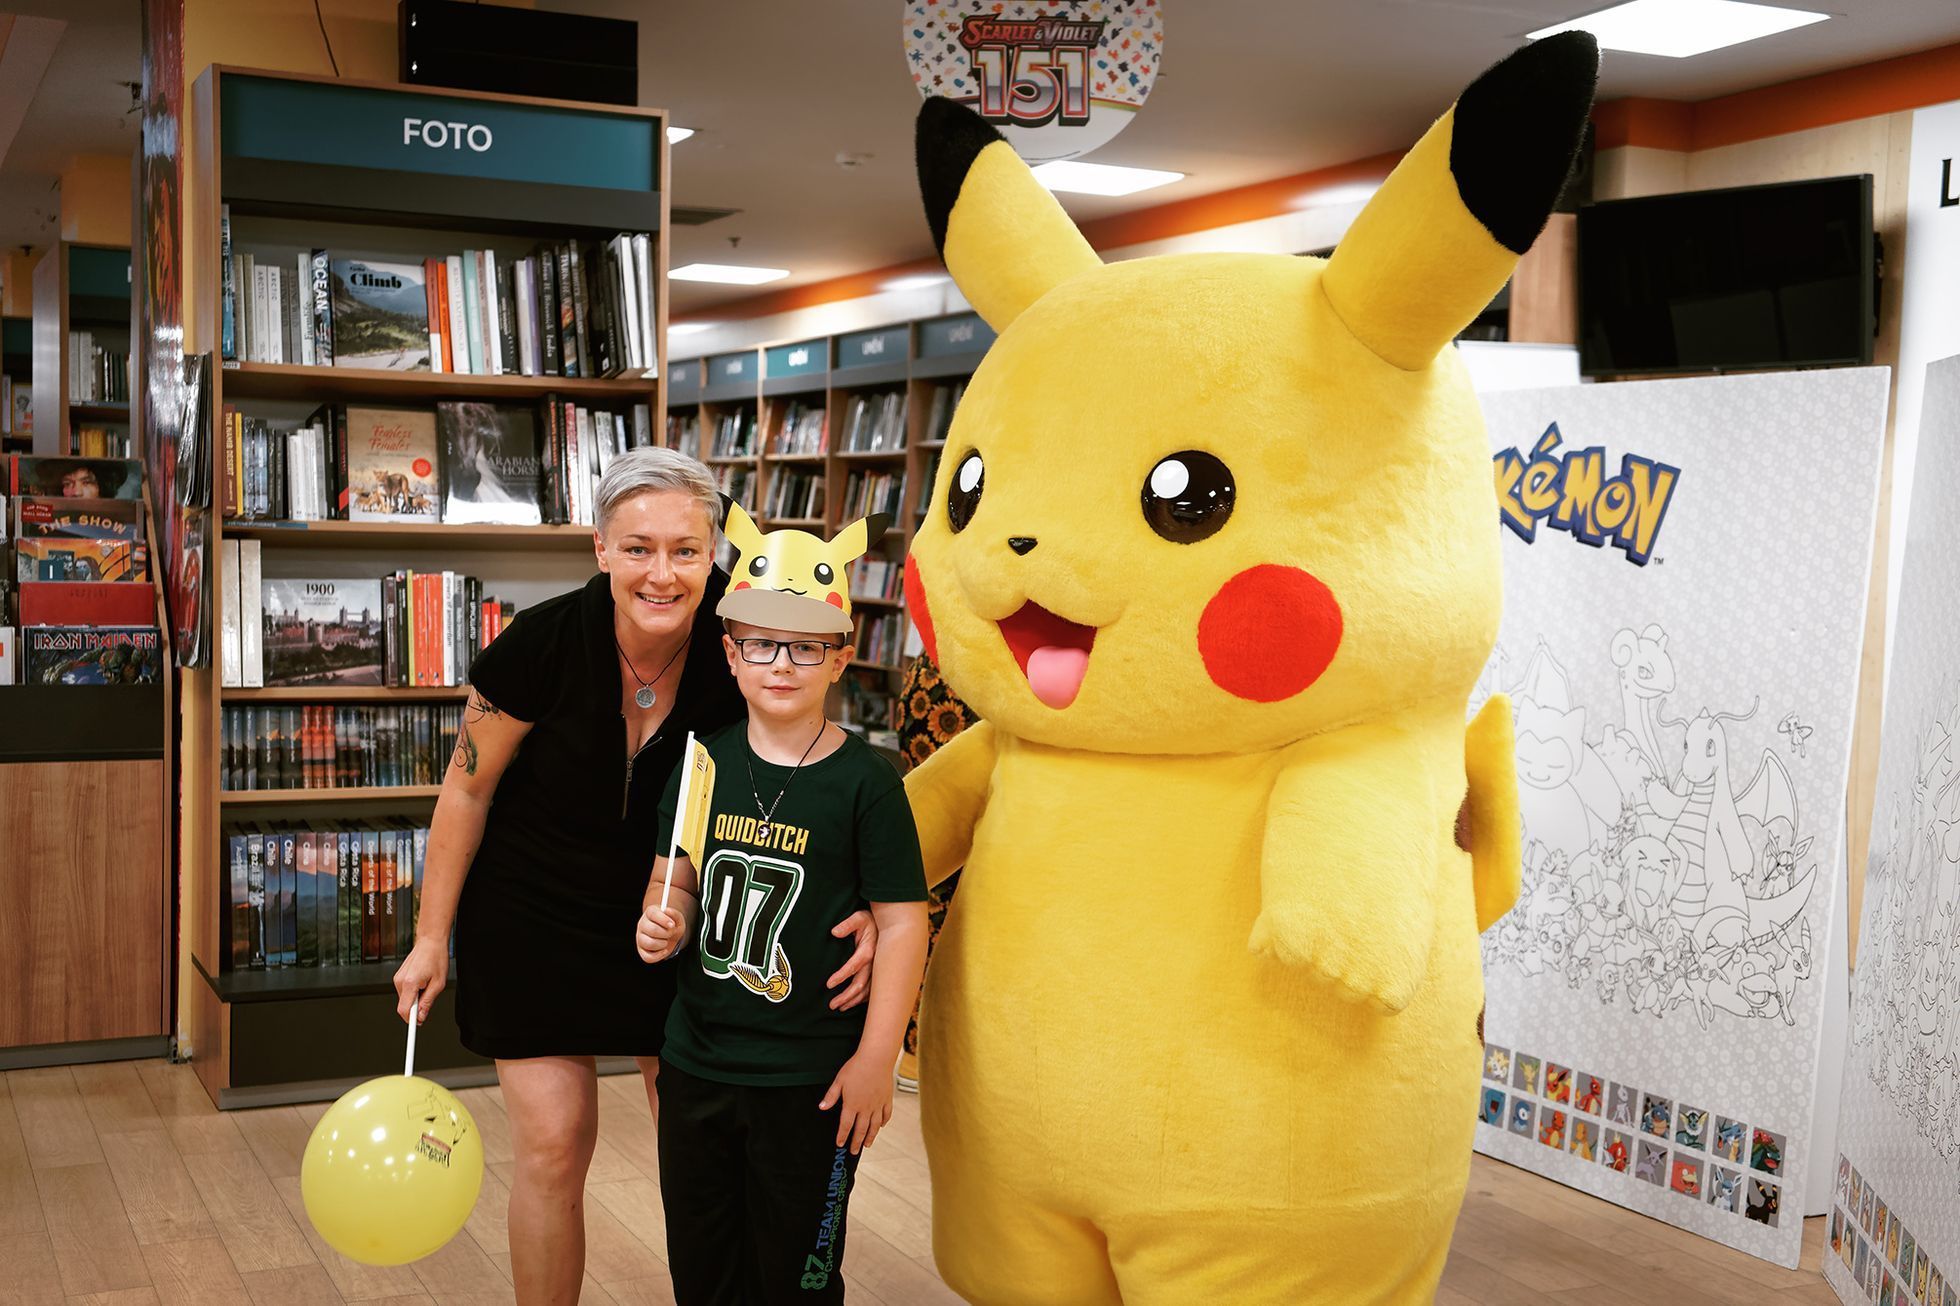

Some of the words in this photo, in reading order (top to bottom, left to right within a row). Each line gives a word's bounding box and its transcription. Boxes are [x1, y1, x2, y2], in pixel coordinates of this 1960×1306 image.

[963, 19, 1037, 45] SCARLET
[1035, 30, 1043, 41] &
[1039, 21, 1098, 45] VIOLET
[972, 46, 1089, 122] 151
[402, 117, 493, 153] FOTO
[257, 271, 265, 301] ARCTIC
[270, 272, 278, 301] ARCTIC
[313, 256, 329, 315] OCEAN
[350, 272, 402, 289] Climb
[546, 334, 556, 357] India
[225, 412, 233, 426] THE
[226, 427, 234, 449] NAMIB
[226, 450, 234, 476] DESERT
[488, 456, 540, 466] ARABIAN
[1493, 421, 1682, 568] KéMON
[38, 518, 72, 536] THE
[78, 515, 127, 534] SHOW
[1654, 557, 1665, 565] TM
[306, 583, 335, 596] 1900
[33, 632, 82, 650] IRON
[84, 632, 158, 650] MAIDEN
[714, 813, 810, 856] QUIDDITCH
[251, 843, 260, 873] Brazil
[266, 840, 276, 867] Chile
[284, 839, 293, 865] Chile
[339, 841, 347, 867] Costa
[351, 841, 359, 866] Costa
[339, 868, 347, 888] Rica
[351, 867, 359, 887] Rica
[701, 849, 805, 980] 07
[837, 1167, 848, 1202] CREW
[816, 1200, 837, 1250] TEAM
[827, 1148, 847, 1198] UNION
[800, 1253, 829, 1291] 87
